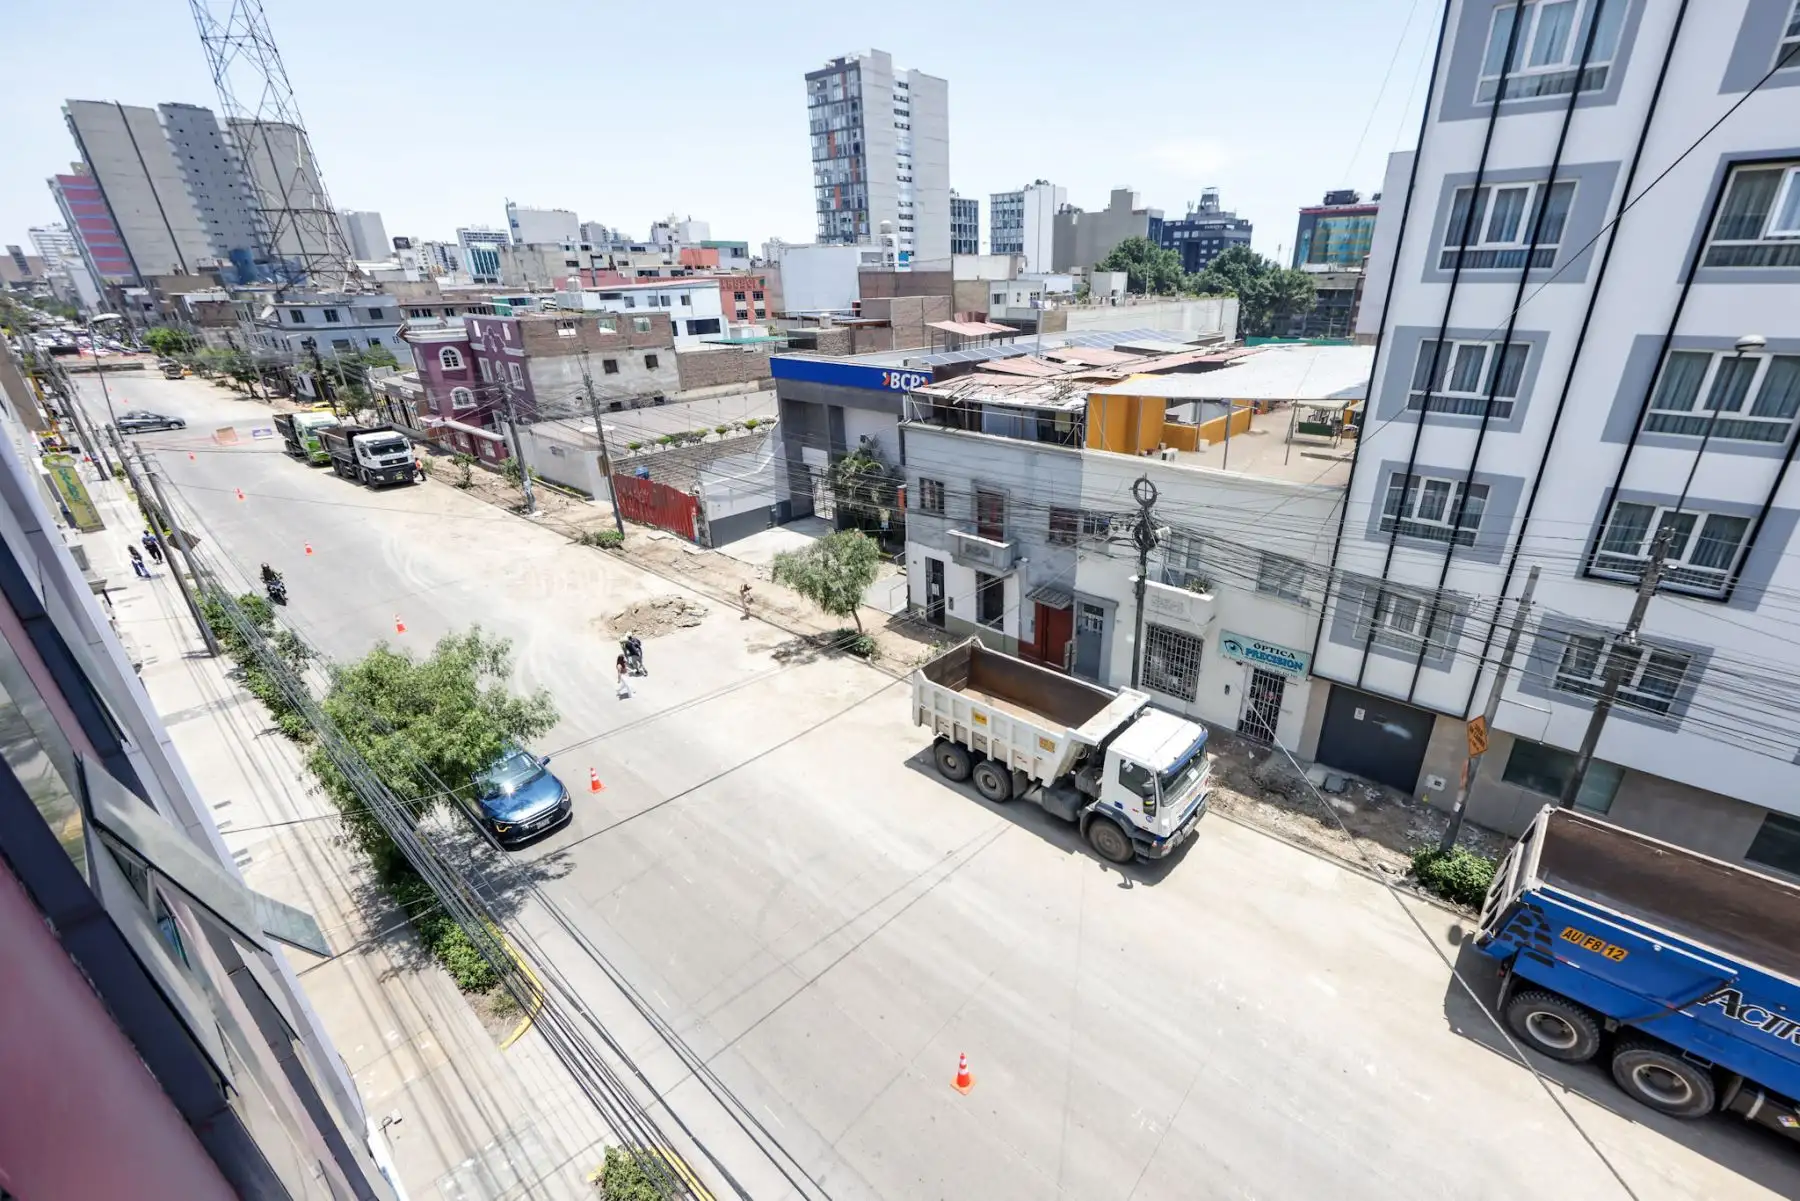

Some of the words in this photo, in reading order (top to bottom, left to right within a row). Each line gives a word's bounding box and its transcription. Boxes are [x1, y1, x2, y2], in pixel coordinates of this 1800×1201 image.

[890, 372, 921, 392] BCP
[1562, 929, 1583, 942] AU
[1583, 937, 1603, 951] F8
[1607, 947, 1625, 960] 12
